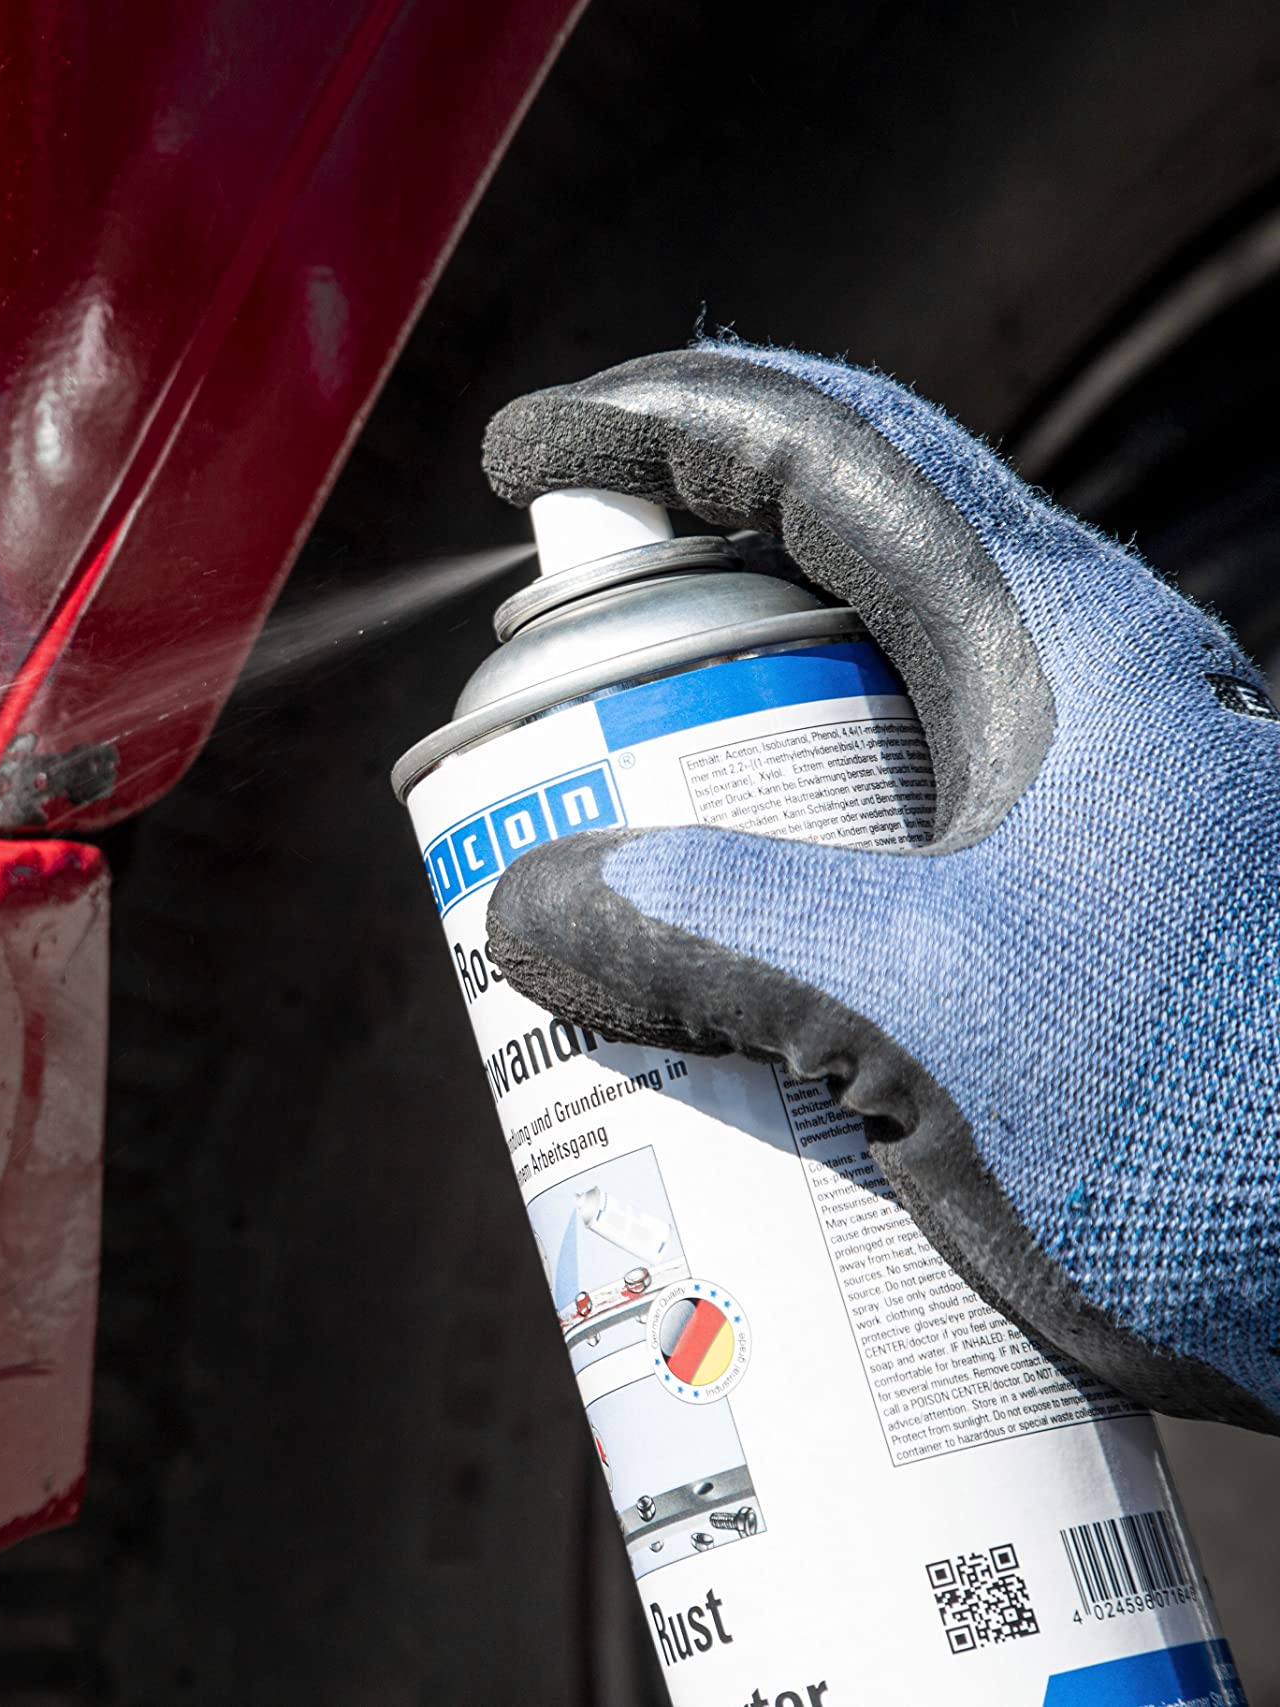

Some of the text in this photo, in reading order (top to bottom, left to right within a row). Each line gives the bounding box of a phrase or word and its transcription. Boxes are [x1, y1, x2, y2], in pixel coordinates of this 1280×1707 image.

[726, 746, 761, 760] Aceton,
[762, 735, 811, 751] Isobutanol,
[812, 729, 841, 740] Phenol,
[691, 772, 709, 783] mer
[712, 768, 727, 778] mit
[792, 760, 825, 775] Extrem
[828, 753, 878, 768] entzündbares
[700, 798, 723, 811] unter
[758, 785, 781, 796] Kann
[783, 781, 796, 791] bei
[797, 771, 847, 788] Erwärmung
[702, 812, 727, 825] Kann
[731, 799, 782, 817] allergische
[784, 785, 850, 804] Hautreaktionen
[783, 808, 806, 819] Kann
[861, 796, 874, 805] und
[788, 823, 802, 833] bei
[841, 813, 858, 823] oder
[820, 832, 838, 843] von
[875, 835, 897, 846] sowie
[454, 939, 506, 1004] Ros
[531, 1108, 552, 1135] und
[554, 1068, 663, 1123] Grundierung
[665, 1058, 689, 1081] in
[786, 1088, 823, 1102] halten.
[530, 1126, 609, 1176] Arbeitsgang
[808, 1154, 857, 1173] Contains:
[821, 1193, 879, 1215] Pressurised
[826, 1218, 847, 1230] May
[850, 1210, 878, 1224] cause
[881, 1206, 892, 1216] an
[830, 1230, 859, 1244] cause
[835, 1240, 883, 1260] prolonged
[886, 1236, 895, 1246] or
[839, 1260, 866, 1273] away
[868, 1253, 891, 1265] from
[892, 1247, 917, 1258] heat,
[886, 1265, 901, 1276] No
[885, 1280, 899, 1292] Do
[901, 1277, 917, 1288] not
[920, 1270, 947, 1285] pierce
[856, 1294, 978, 1330] work clothing should not
[884, 1295, 904, 1308] Use
[907, 1290, 926, 1302] only
[651, 1287, 686, 1350] German Quality
[860, 1325, 911, 1346] protective
[914, 1312, 965, 1333] gloves/eye
[864, 1333, 939, 1358] CENTER/doctor
[943, 1330, 948, 1339] if
[952, 1326, 968, 1340] you
[970, 1320, 987, 1332] feel
[870, 1360, 894, 1374] soap
[897, 1354, 915, 1366] and
[918, 1348, 949, 1361] water.
[950, 1342, 959, 1352] IF
[962, 1332, 1006, 1350] INHALED:
[706, 1332, 746, 1397] Industrial grade
[874, 1367, 933, 1388] comfortable
[935, 1362, 950, 1372] for
[952, 1351, 996, 1368] breathing.
[999, 1346, 1008, 1357] IF
[1009, 1344, 1020, 1355] IN
[878, 1390, 895, 1402] for
[894, 1384, 929, 1400] several
[973, 1363, 1013, 1378] Remove
[1011, 1357, 1040, 1370] contact
[884, 1405, 901, 1417] call
[910, 1392, 950, 1408] POISON
[1024, 1372, 1036, 1383] Do
[1038, 1367, 1052, 1380] NOT
[972, 1397, 998, 1410] Store
[1000, 1394, 1009, 1405] in
[1020, 1380, 1076, 1400] well-ventilated
[892, 1430, 926, 1445] Protect
[928, 1423, 951, 1436] from
[993, 1409, 1006, 1421] Do
[1007, 1408, 1023, 1417] not
[1022, 1401, 1052, 1417] expose
[1052, 1398, 1060, 1408] to
[897, 1441, 942, 1460] container
[945, 1438, 956, 1448] to
[957, 1426, 1006, 1445] hazardous
[1008, 1423, 1017, 1433] or
[1020, 1416, 1049, 1431] special
[1050, 1411, 1074, 1423] waste
[650, 1588, 733, 1666] Rust
